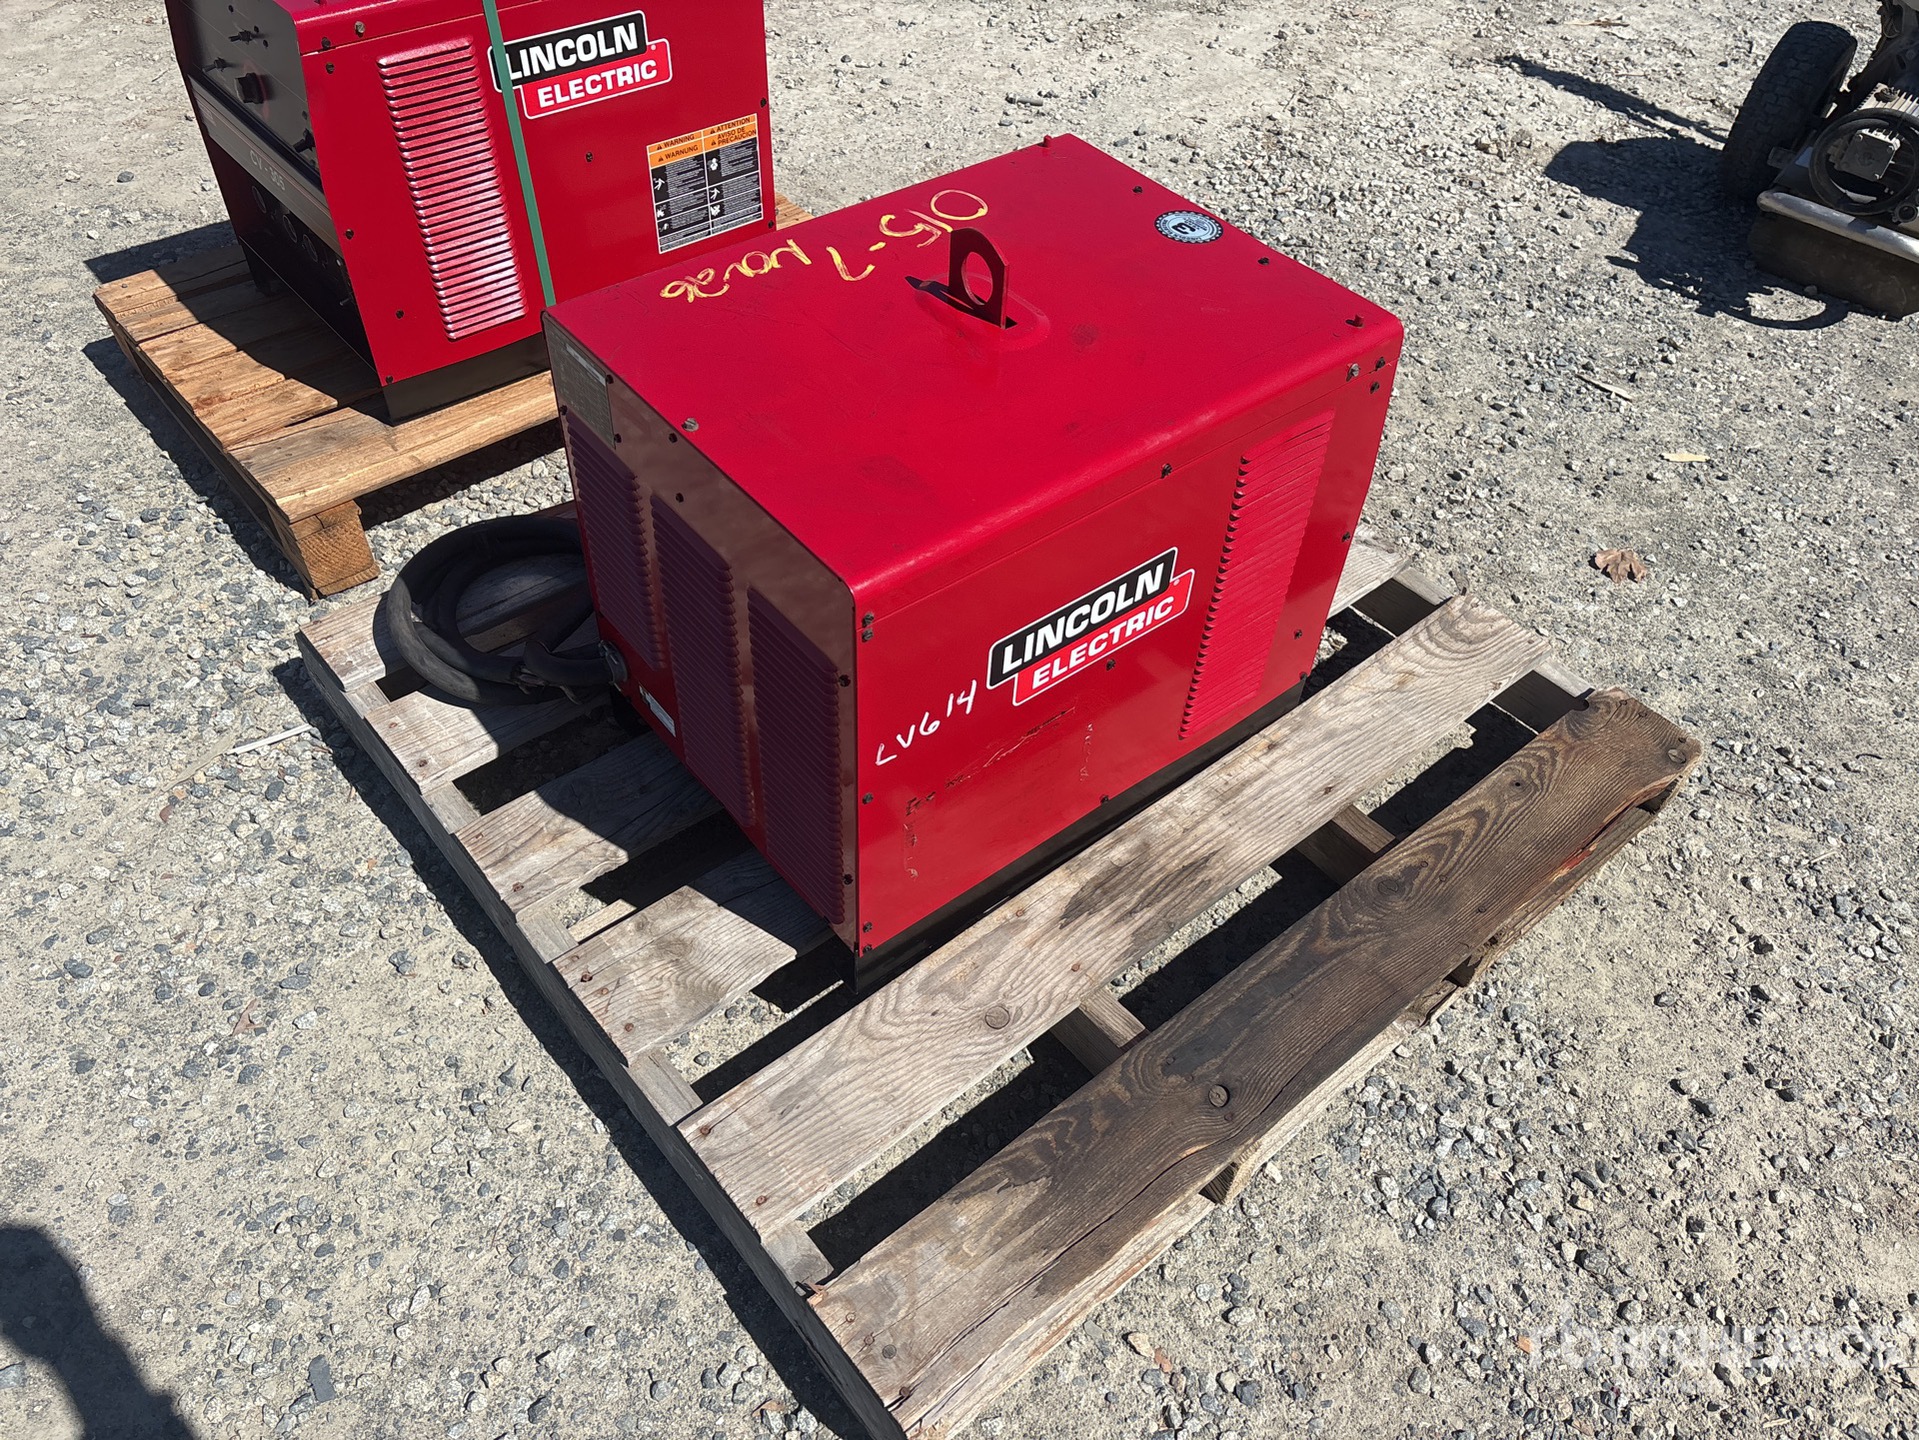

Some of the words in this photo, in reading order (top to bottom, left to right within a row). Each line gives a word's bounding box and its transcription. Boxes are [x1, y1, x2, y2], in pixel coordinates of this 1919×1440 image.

[505, 22, 638, 80] LINCOLN
[537, 59, 658, 108] ELECTRIC
[663, 133, 695, 148] WARNING
[716, 117, 751, 132] ATTENTION
[717, 129, 736, 140] AVISO
[737, 126, 745, 134] DE
[665, 144, 699, 160] WARNUNG
[1002, 562, 1165, 675] LINCOLN
[1032, 596, 1175, 690] ELECTRIC
